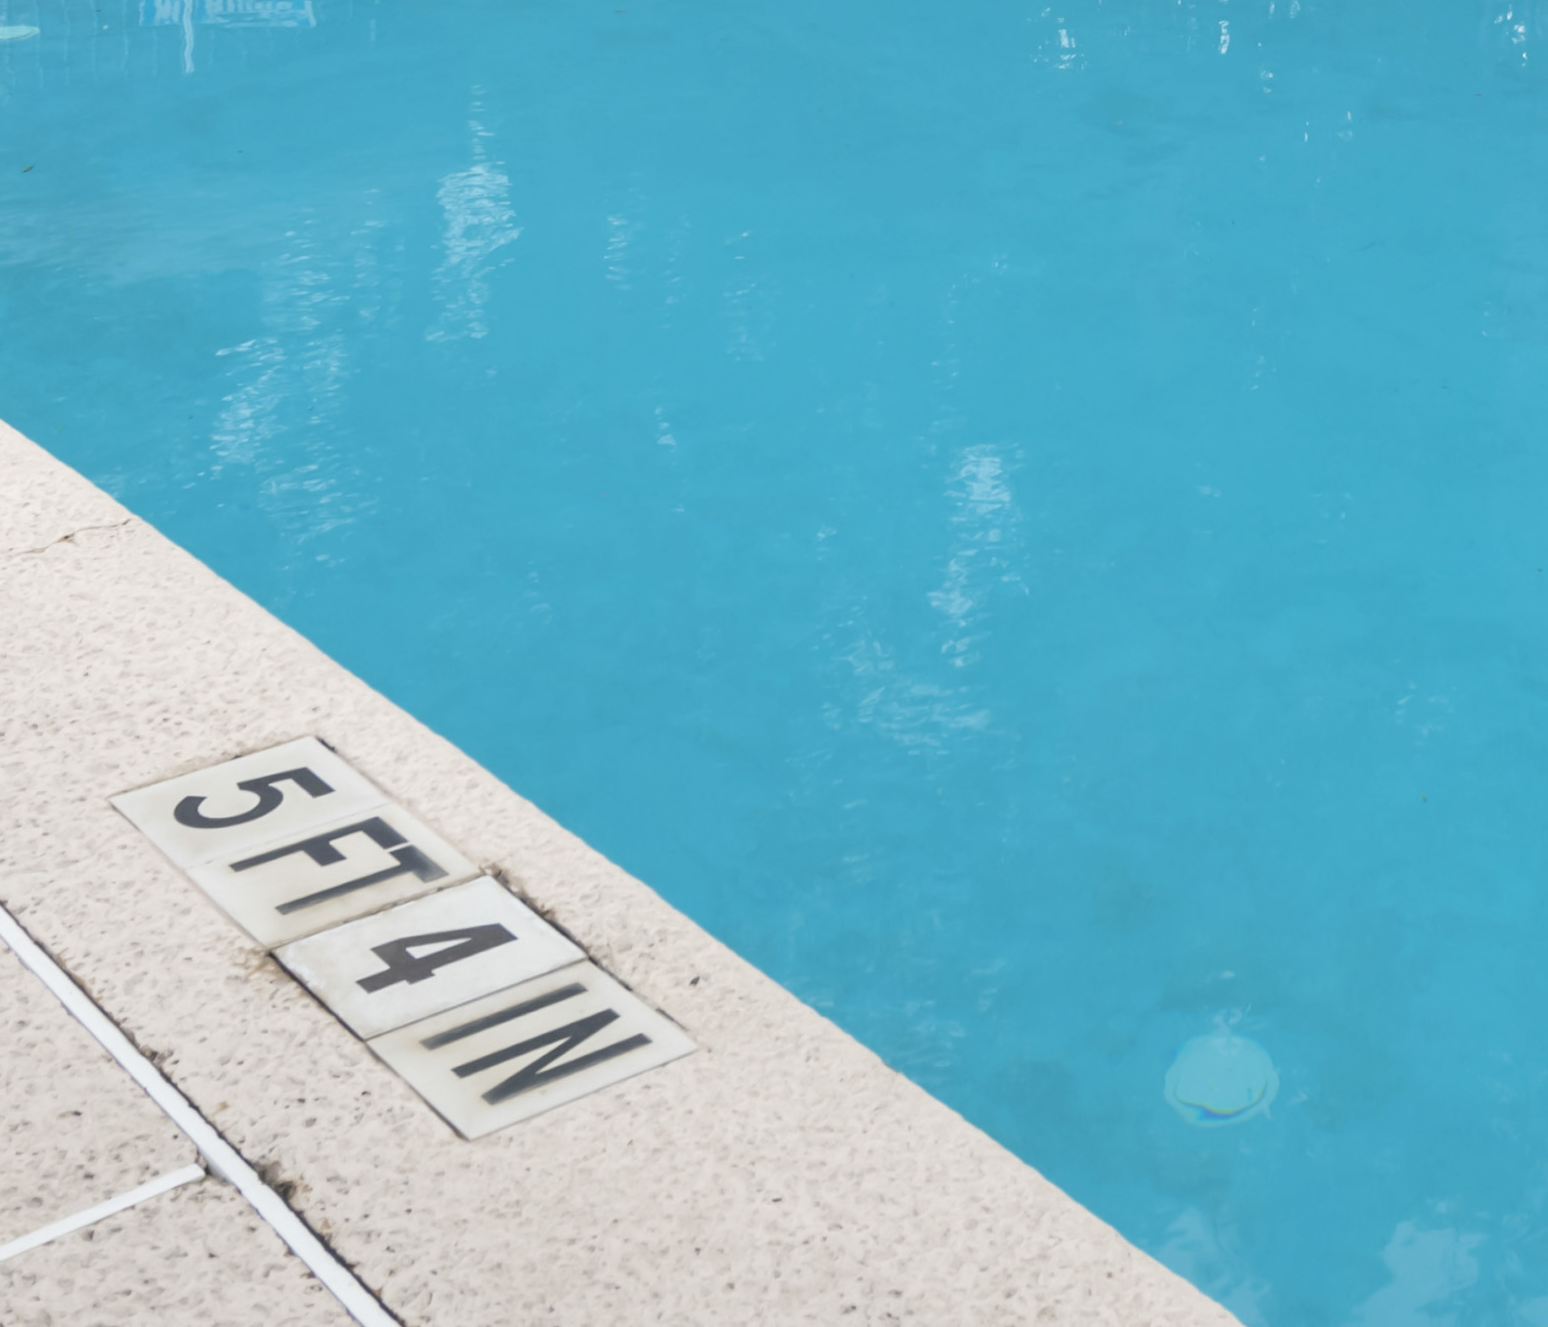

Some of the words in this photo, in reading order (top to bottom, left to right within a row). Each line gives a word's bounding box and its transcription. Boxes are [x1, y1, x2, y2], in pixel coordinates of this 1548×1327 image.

[173, 766, 336, 830] 5
[228, 816, 450, 916] FT
[354, 922, 519, 995] 4
[418, 982, 654, 1106] IN
